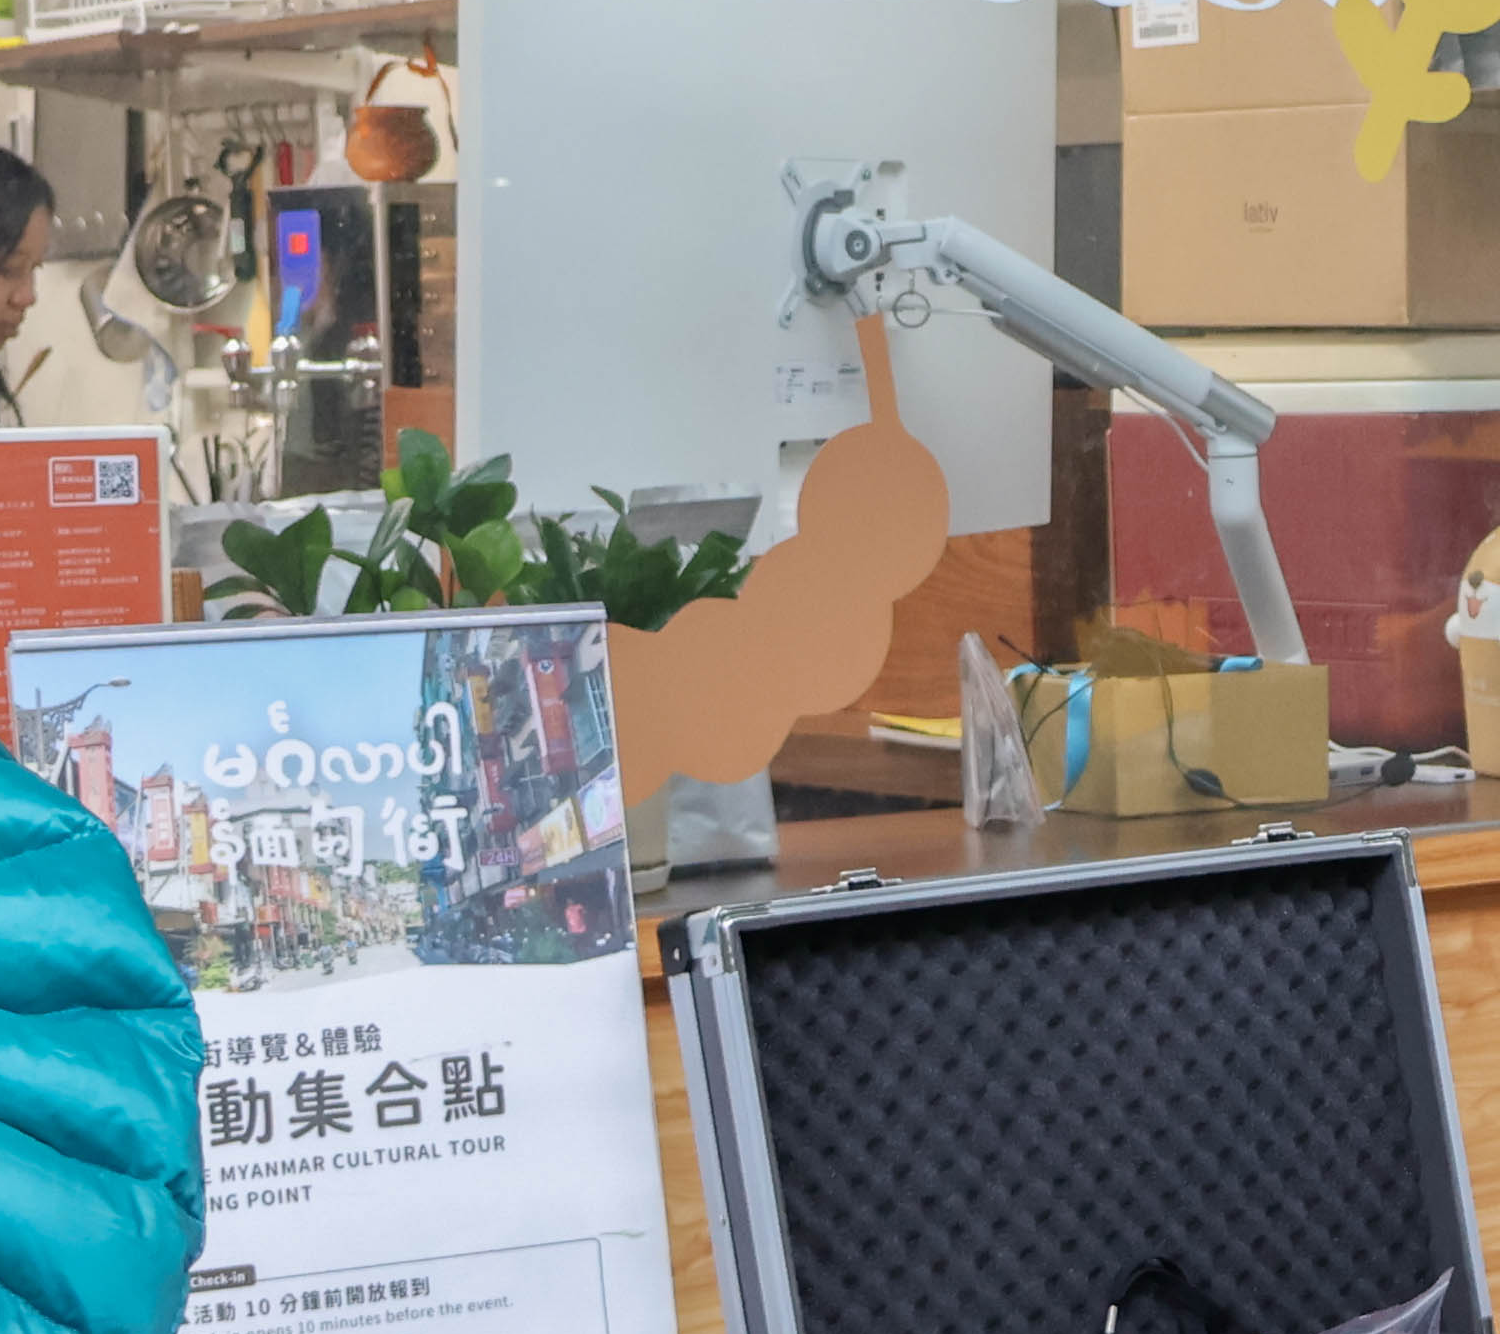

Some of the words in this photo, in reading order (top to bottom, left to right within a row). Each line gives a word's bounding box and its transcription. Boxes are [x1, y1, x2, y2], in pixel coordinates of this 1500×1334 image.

[205, 1051, 505, 1147] 動集合點
[220, 1155, 325, 1183] MYANMAR
[332, 1143, 441, 1170] CULTURAL
[449, 1135, 506, 1157] TOUR
[247, 1185, 312, 1208] POINT
[190, 1271, 245, 1289] Check-in
[194, 1300, 235, 1324] 活動
[245, 1298, 270, 1318] 10
[280, 1276, 430, 1314] 分鐘前開放報到
[320, 1311, 381, 1332] minutes
[386, 1303, 435, 1325] before
[439, 1300, 463, 1316] the
